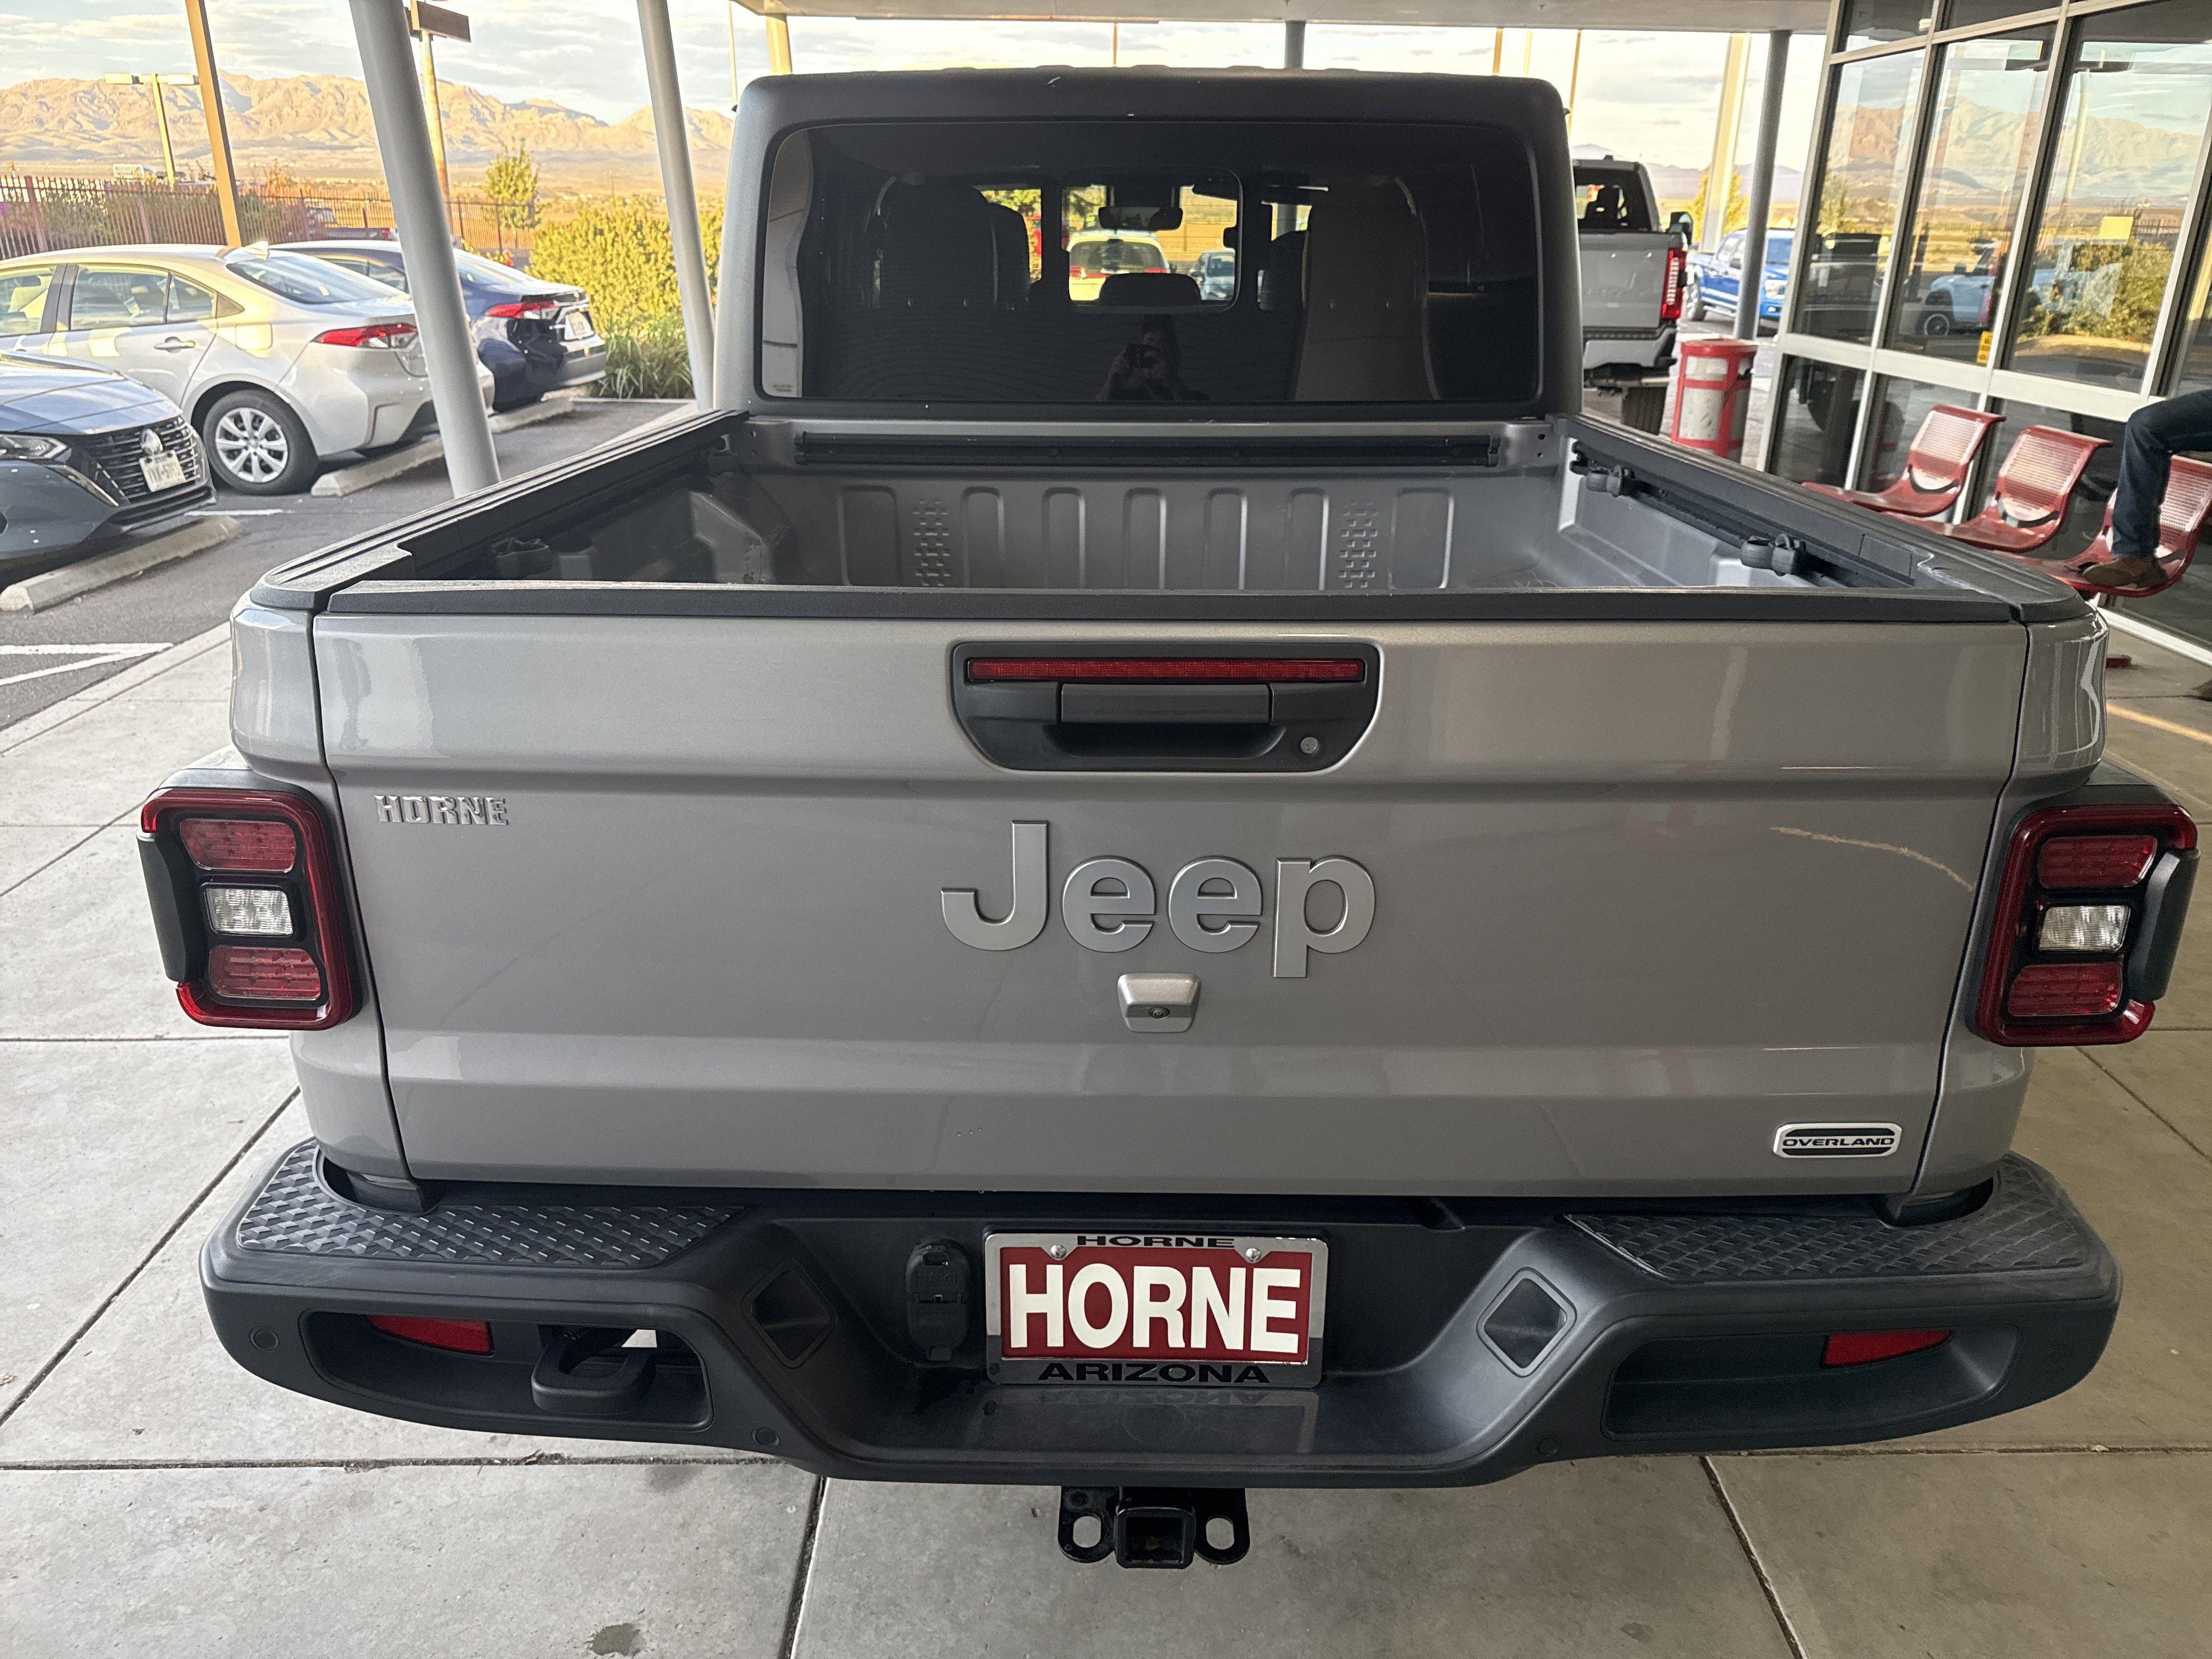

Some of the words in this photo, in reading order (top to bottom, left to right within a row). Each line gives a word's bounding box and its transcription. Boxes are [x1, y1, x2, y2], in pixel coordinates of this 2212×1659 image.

[374, 795, 508, 825] HORNE
[940, 820, 1376, 978] Jeep
[1783, 1138, 1894, 1146] OVERLAND
[1077, 1235, 1234, 1248] HORNE
[1009, 1263, 1301, 1353] HORNE
[1037, 1362, 1270, 1383] ARIZONA
